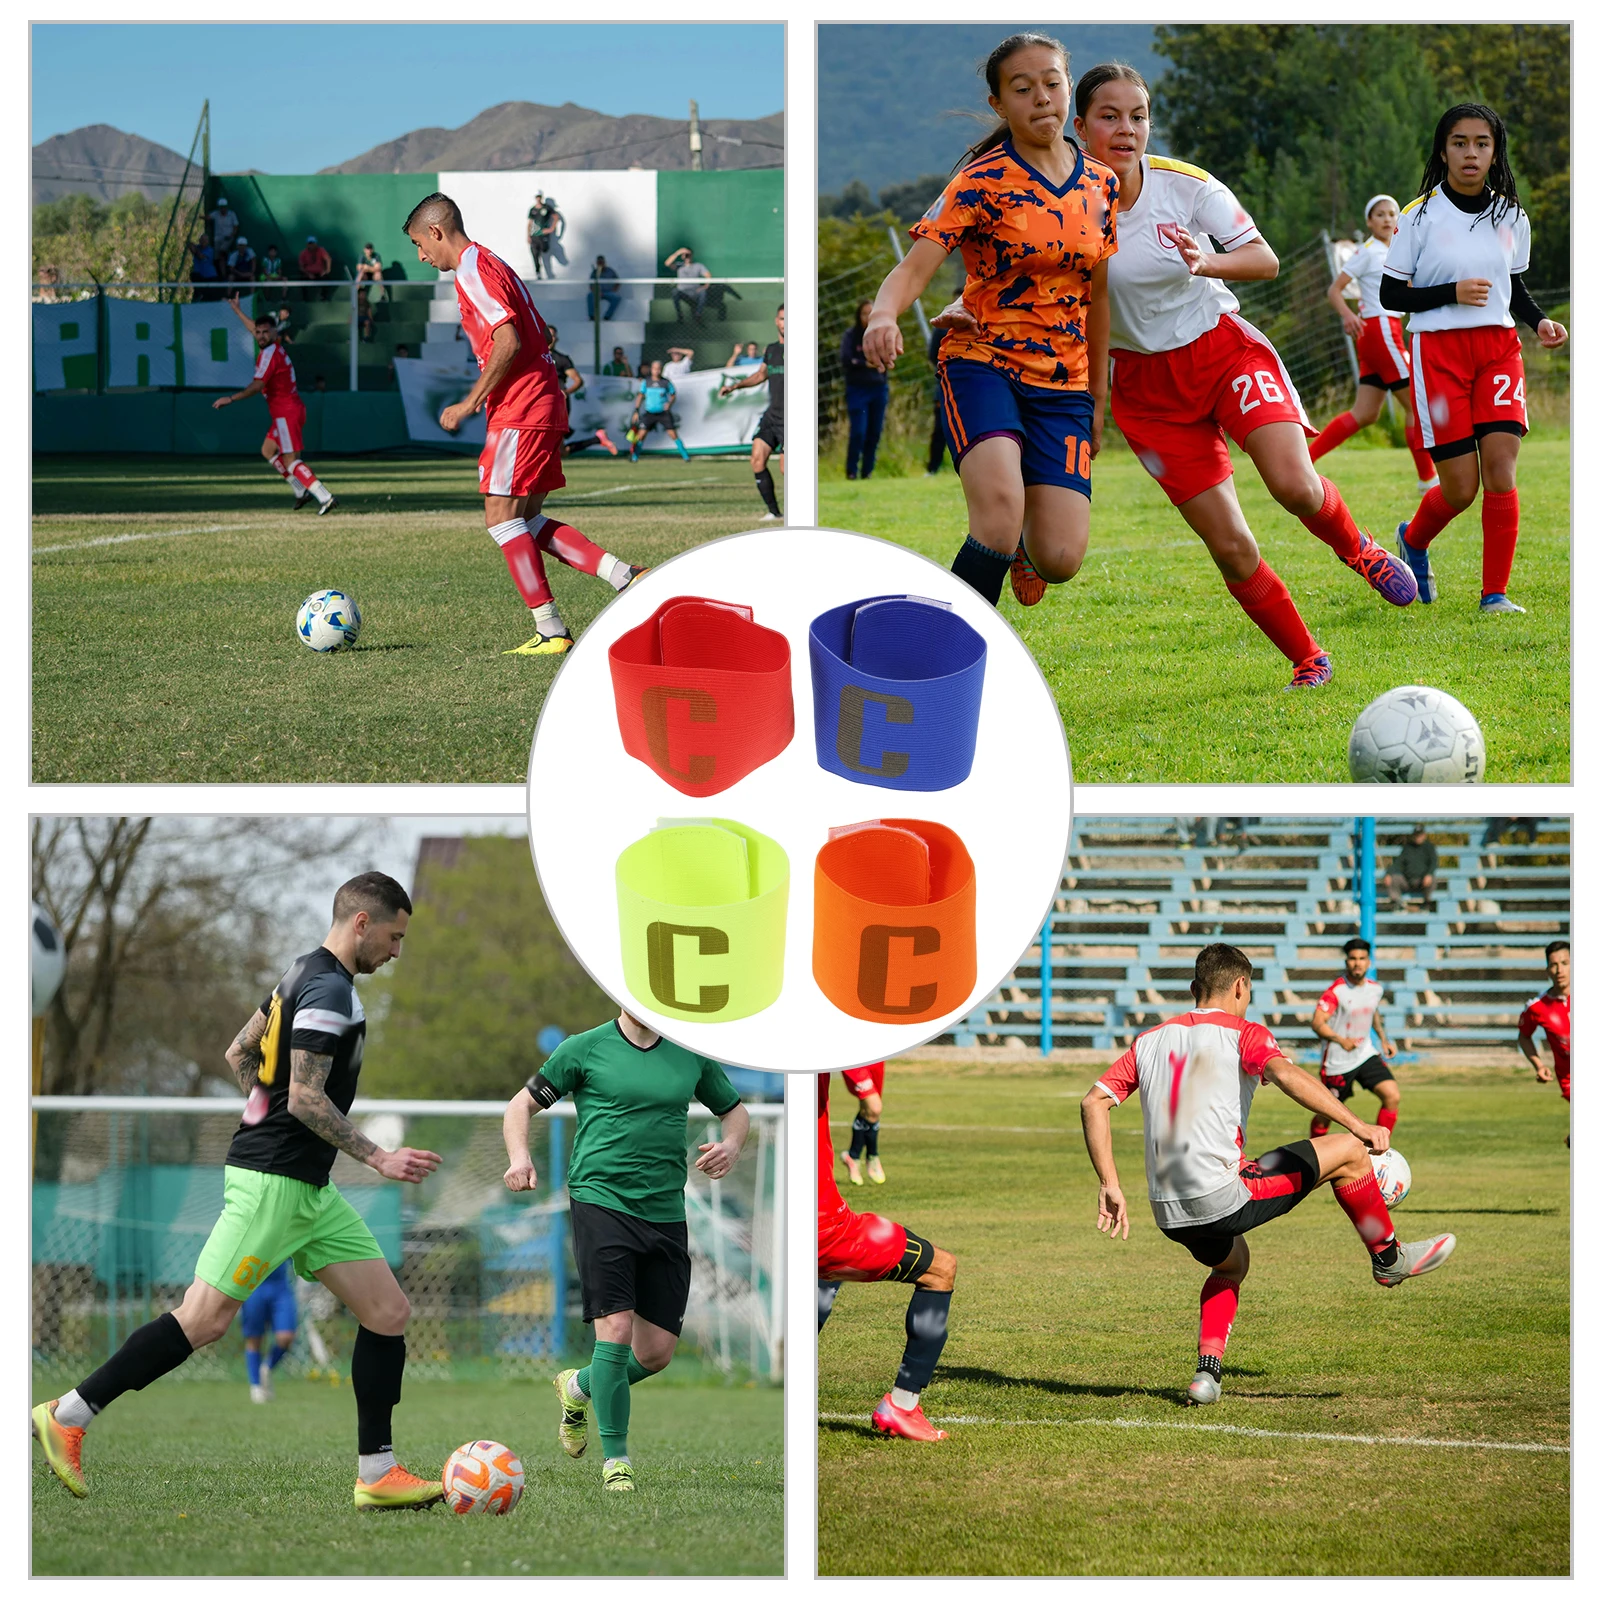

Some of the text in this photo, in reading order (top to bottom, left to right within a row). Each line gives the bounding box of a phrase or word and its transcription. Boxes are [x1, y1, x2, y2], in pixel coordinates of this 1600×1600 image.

[33, 298, 254, 389] PRO
[1231, 370, 1285, 415] 26
[1493, 374, 1526, 409] 24
[1064, 435, 1091, 480] 16
[641, 685, 718, 784] C
[835, 684, 915, 779] C
[1462, 733, 1479, 783] LTY
[646, 921, 729, 1013] C
[857, 924, 941, 1015] C
